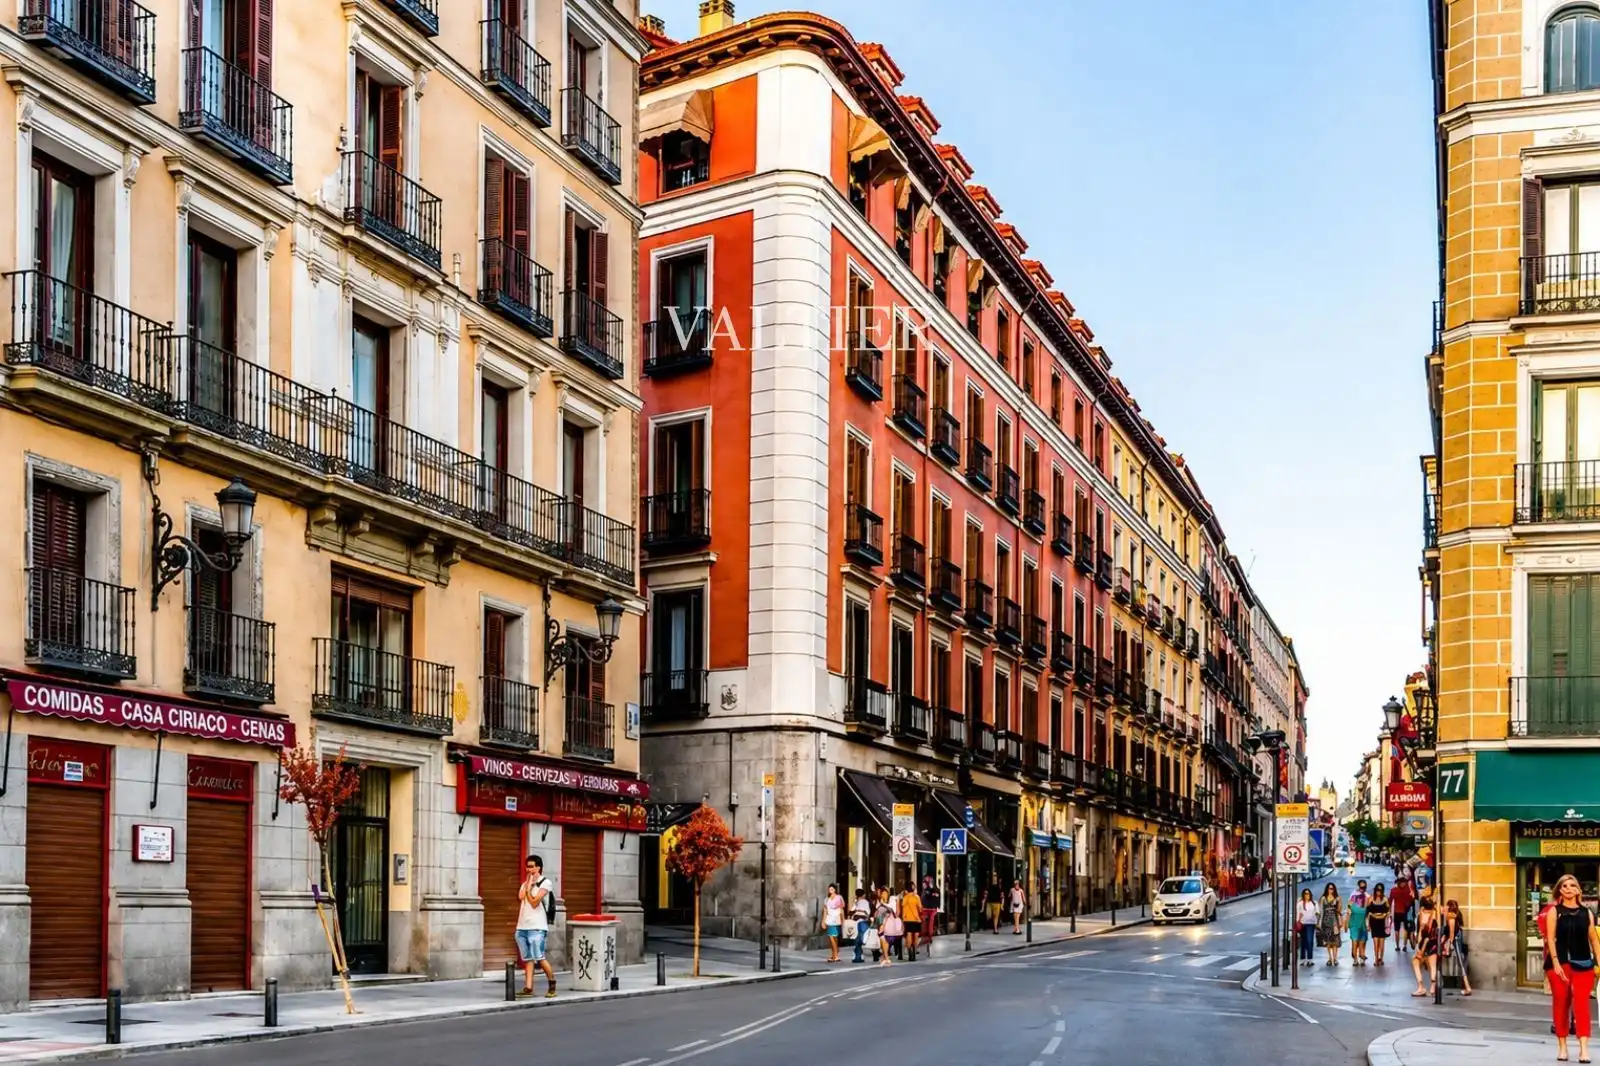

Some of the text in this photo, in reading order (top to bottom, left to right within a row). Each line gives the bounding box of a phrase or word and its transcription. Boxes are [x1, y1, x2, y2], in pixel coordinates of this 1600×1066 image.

[24, 685, 104, 716] COMIDAS
[121, 701, 164, 725] CASA
[168, 708, 228, 733] CIRIACO
[240, 718, 285, 741] CENAS
[482, 758, 513, 777] VINOS
[522, 765, 570, 785] CERVEZAS
[1440, 769, 1465, 794] 77
